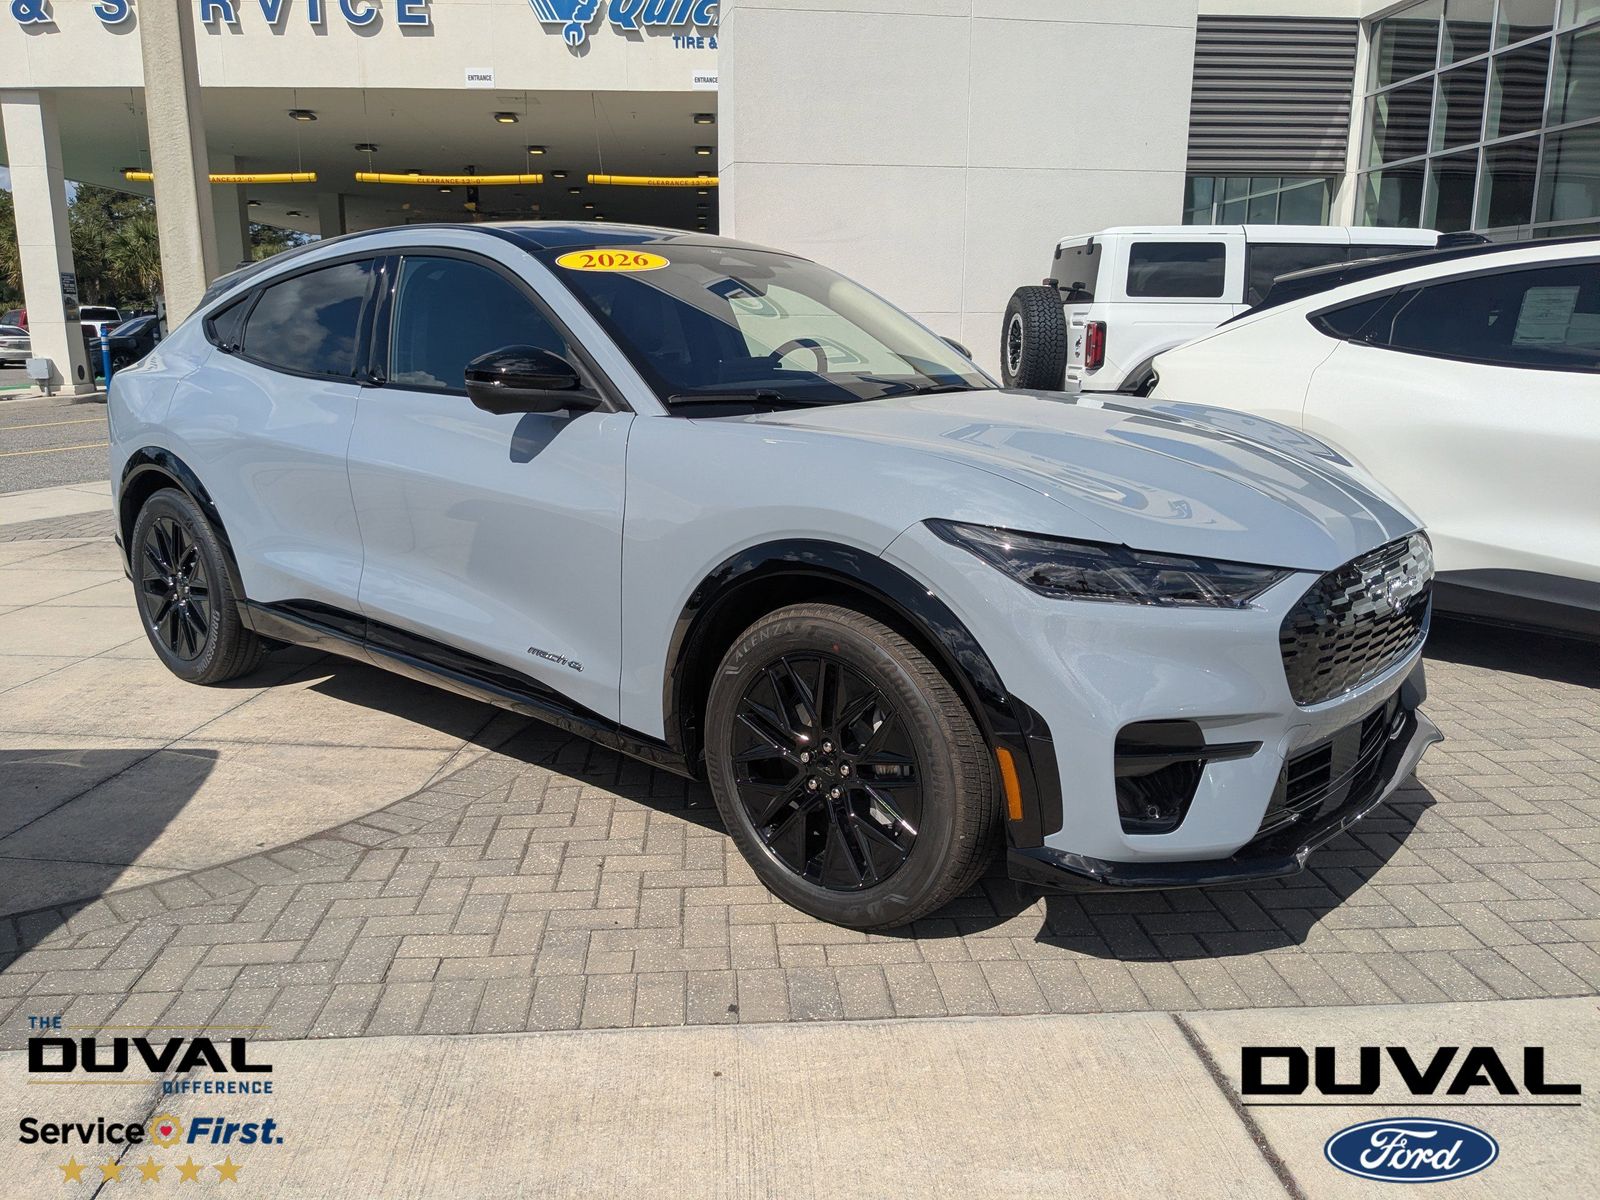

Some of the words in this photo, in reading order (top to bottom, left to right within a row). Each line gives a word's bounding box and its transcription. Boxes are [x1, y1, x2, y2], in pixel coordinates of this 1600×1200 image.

[92, 0, 429, 25] SRVICE
[672, 36, 705, 49] TIRE
[467, 73, 493, 82] ENTRANCE
[693, 76, 719, 84] ENTRANCE
[579, 253, 649, 268] 2026
[735, 620, 795, 663] ALENZA
